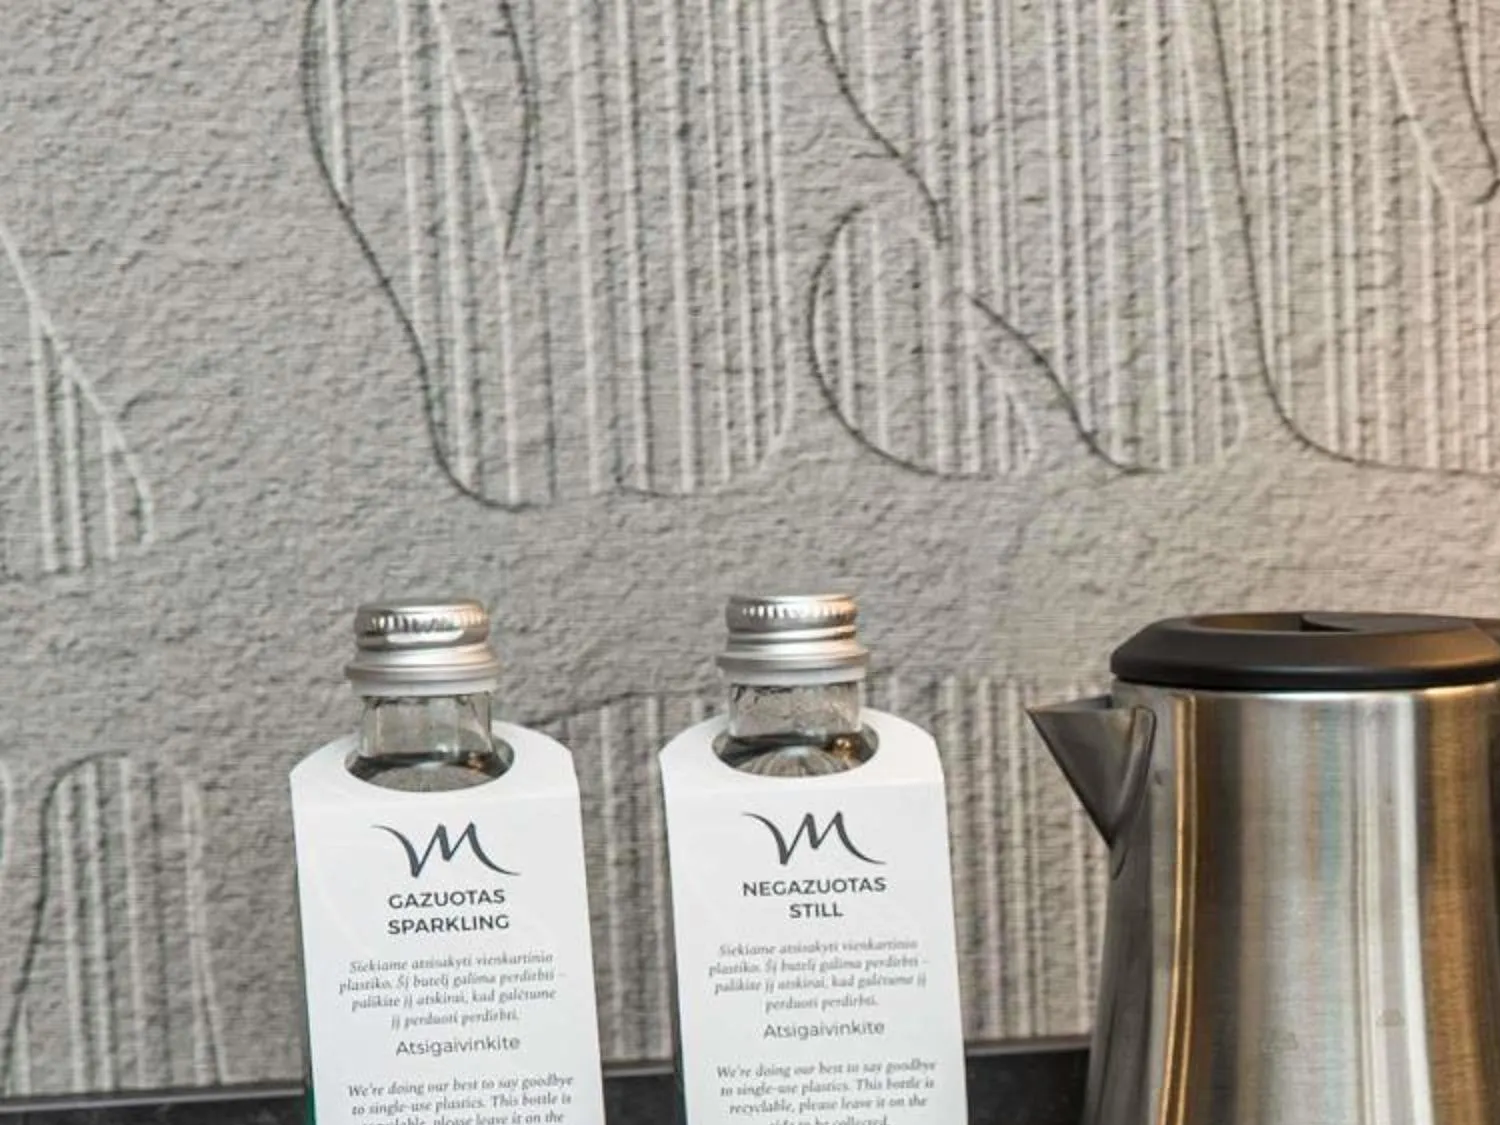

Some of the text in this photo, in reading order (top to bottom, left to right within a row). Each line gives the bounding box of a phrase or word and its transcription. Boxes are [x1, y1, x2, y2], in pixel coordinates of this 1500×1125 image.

[742, 876, 887, 898] NEGAZUOTAS
[388, 888, 505, 910] GAZUOTAS
[789, 902, 844, 919] STILL
[387, 914, 510, 935] SPARKLING
[472, 988, 494, 1002] kad
[763, 1020, 885, 1041] Atsigaivinkite
[396, 1035, 520, 1057] Atsigaivinkite
[755, 1063, 790, 1078] doing
[819, 1062, 843, 1074] best
[887, 1058, 936, 1073] goodbye
[349, 1073, 573, 1097] We're doing our best to say goodbye
[737, 1082, 798, 1097] single-use
[856, 1078, 883, 1090] This
[886, 1076, 922, 1089] bottle
[352, 1104, 364, 1115] to
[369, 1100, 431, 1117] single-use
[491, 1095, 517, 1107] This
[522, 1092, 557, 1106] bottle
[561, 1093, 571, 1104] is
[799, 1098, 837, 1114] please
[841, 1097, 872, 1110] leave
[908, 1095, 927, 1107] the
[476, 1114, 508, 1125] leave
[525, 1114, 541, 1124] on
[545, 1110, 564, 1123] the
